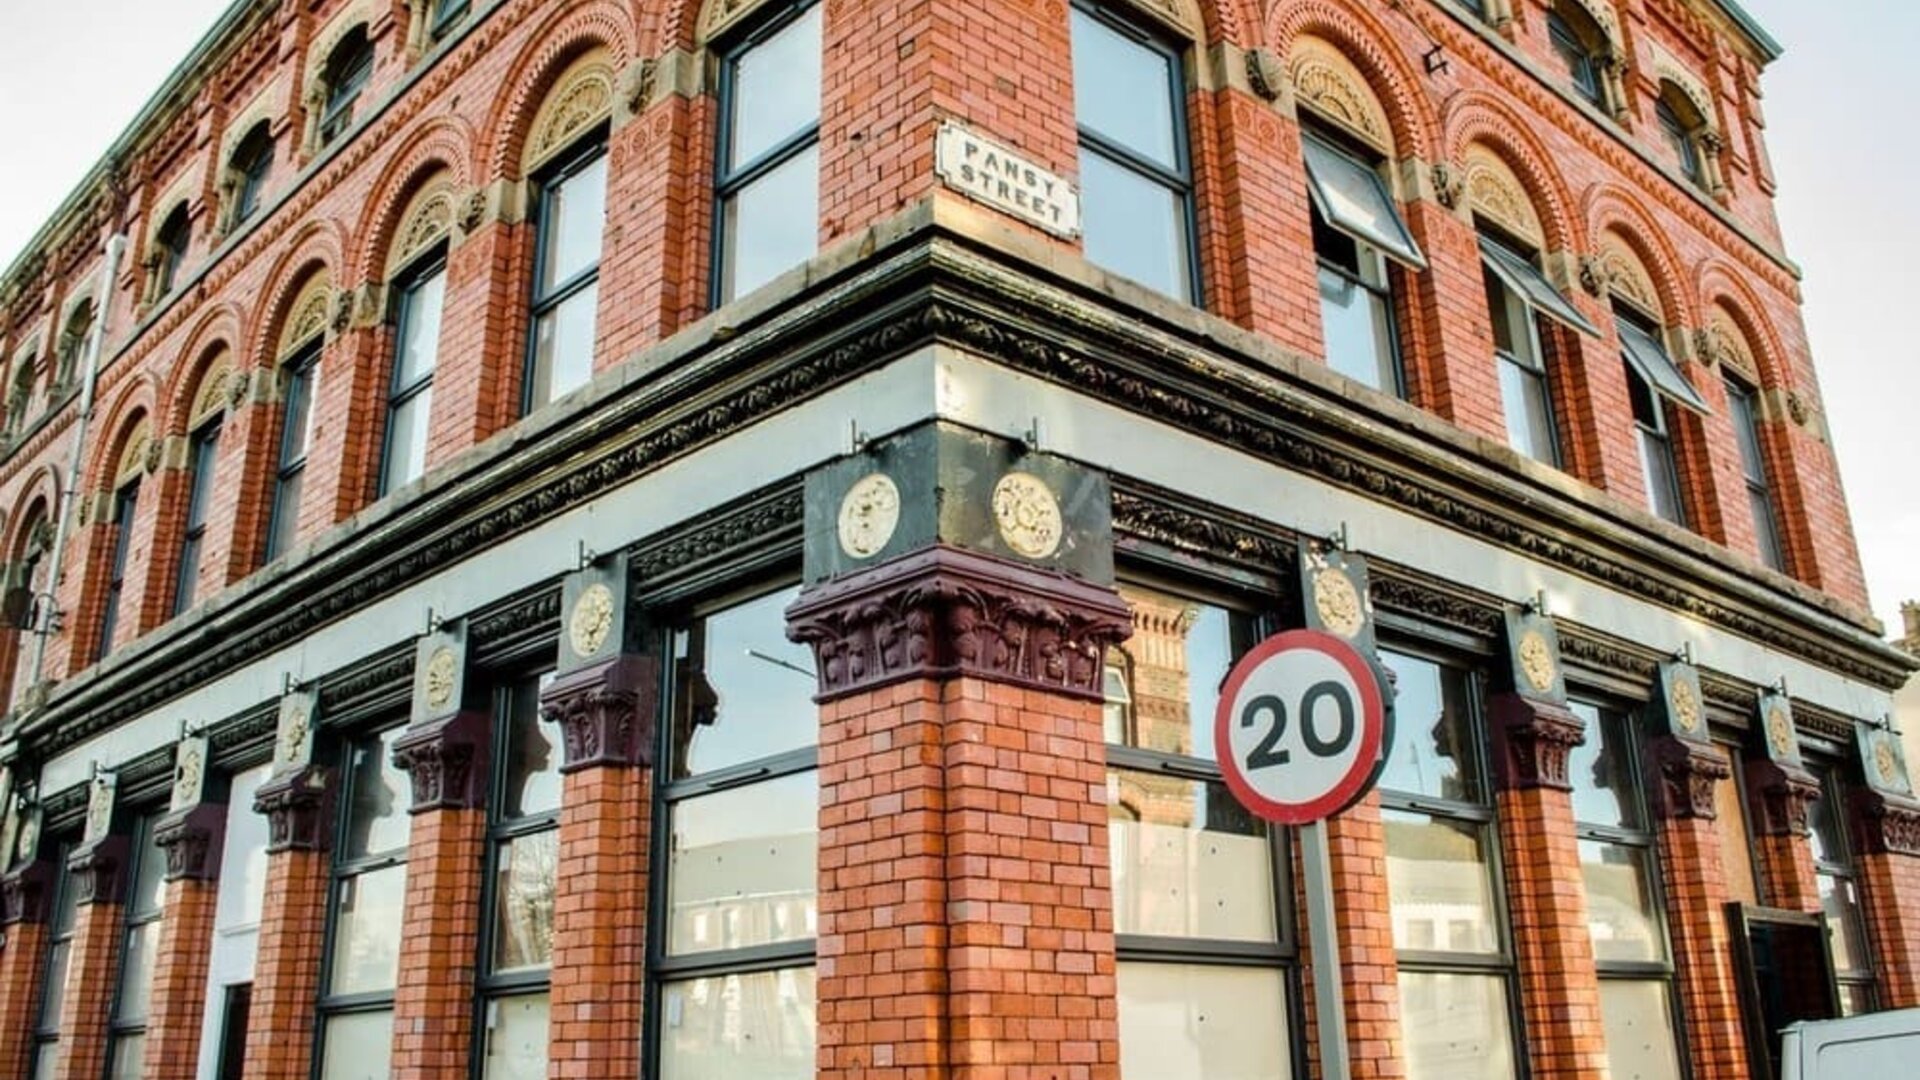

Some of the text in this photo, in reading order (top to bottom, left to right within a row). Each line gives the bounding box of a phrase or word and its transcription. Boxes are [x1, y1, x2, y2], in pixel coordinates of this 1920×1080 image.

[962, 165, 1061, 222] STREET
[965, 142, 1054, 196] PANSY
[1242, 681, 1354, 770] 20
